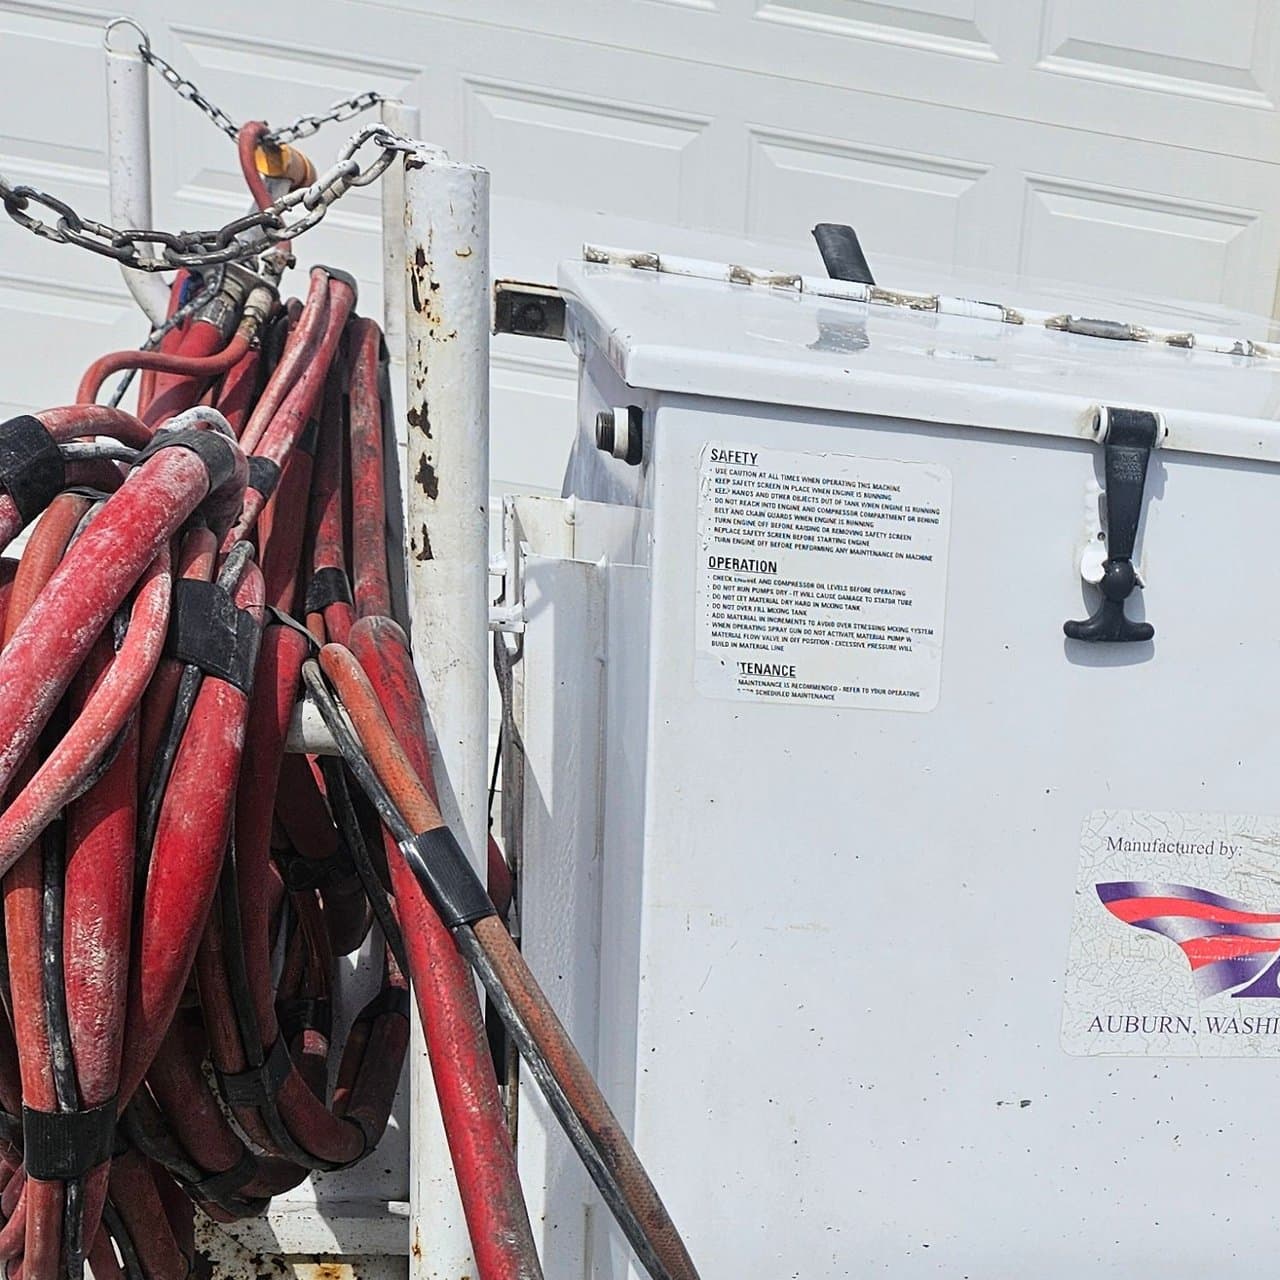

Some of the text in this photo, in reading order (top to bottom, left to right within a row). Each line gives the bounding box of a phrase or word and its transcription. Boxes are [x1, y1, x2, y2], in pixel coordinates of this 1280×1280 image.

[711, 448, 759, 465] SAFETY
[708, 555, 778, 573] OPERATION
[737, 661, 796, 677] TENANCE
[1106, 836, 1243, 858] Manufactured by:
[1088, 1015, 1198, 1036] AUBURN,
